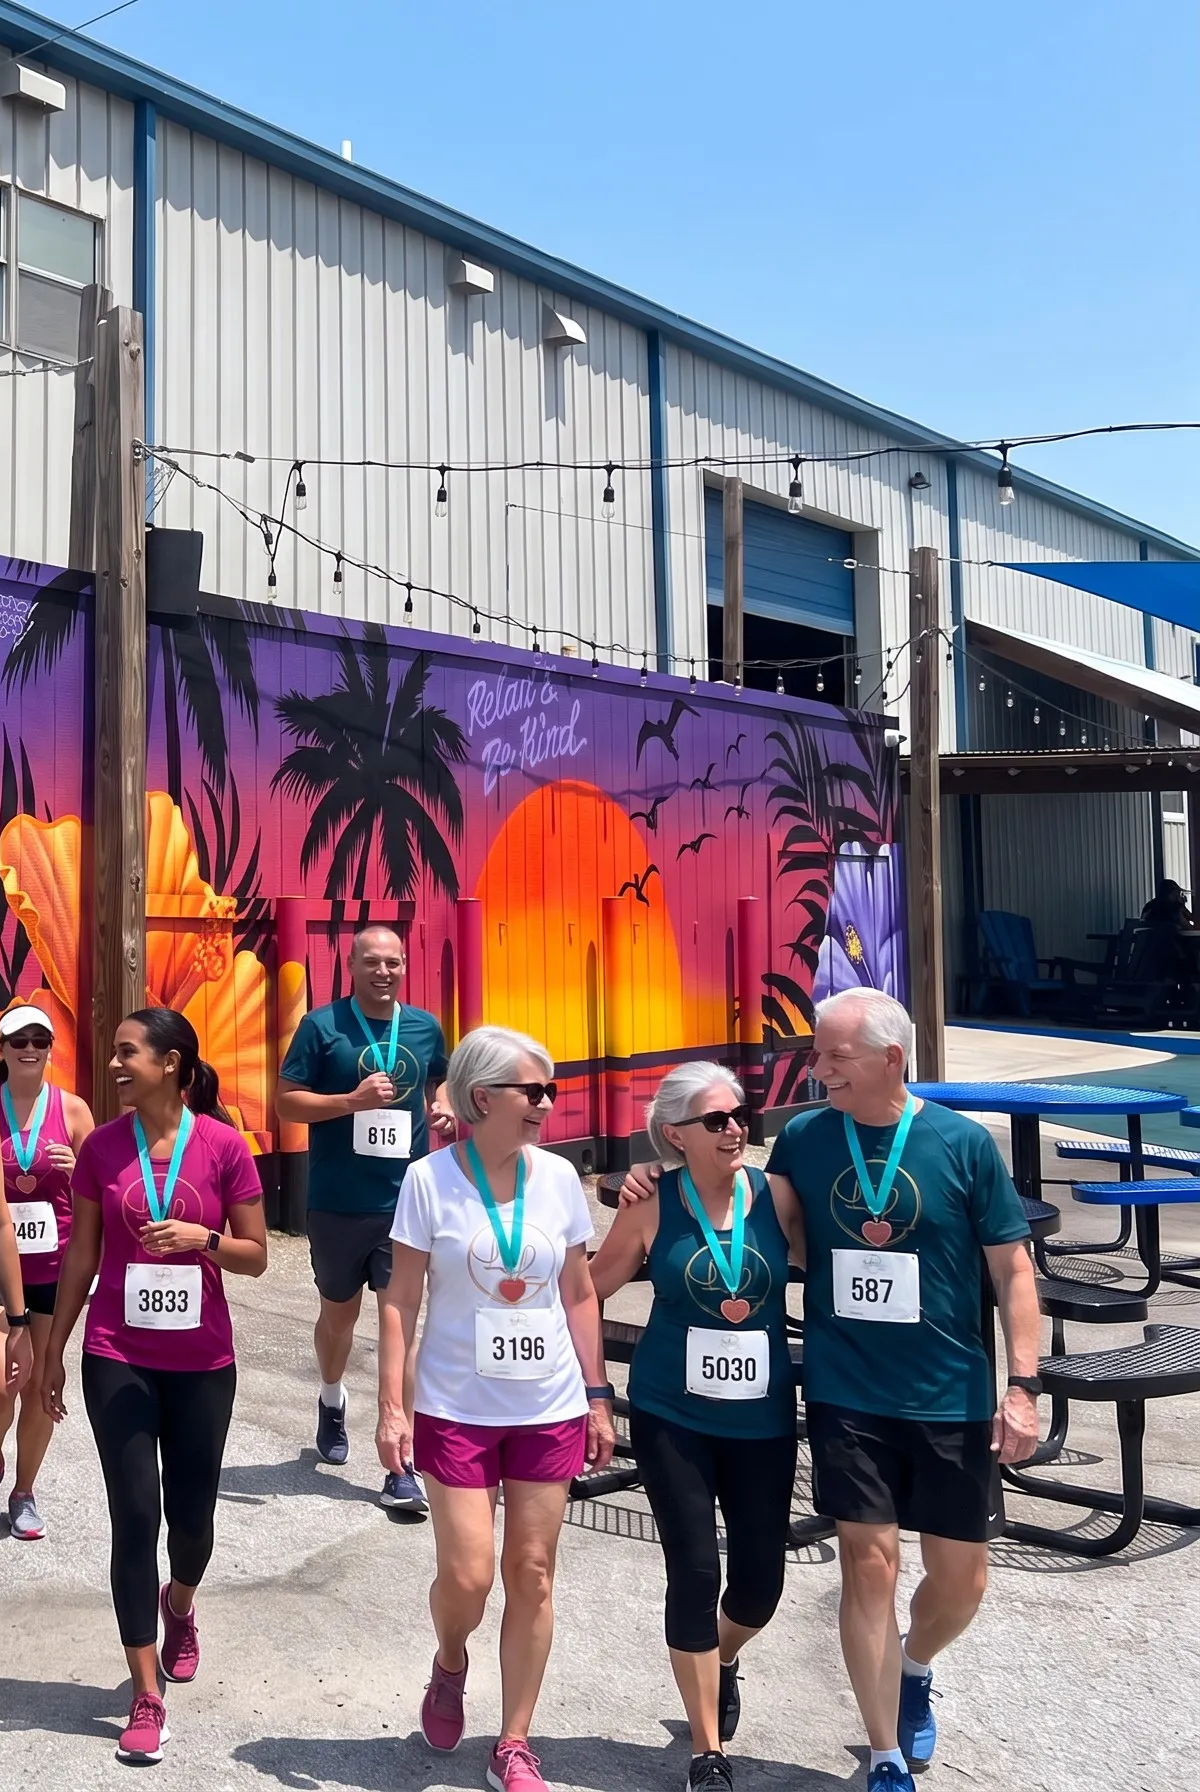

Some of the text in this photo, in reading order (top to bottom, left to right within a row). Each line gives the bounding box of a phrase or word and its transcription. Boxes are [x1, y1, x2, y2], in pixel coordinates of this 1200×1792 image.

[519, 699, 588, 770] Kind
[367, 1125, 397, 1146] 815
[12, 1221, 46, 1240] 487
[138, 1288, 189, 1313] 3833
[851, 1276, 894, 1304] 587
[492, 1336, 545, 1362] 3196
[702, 1355, 757, 1382] 5030
